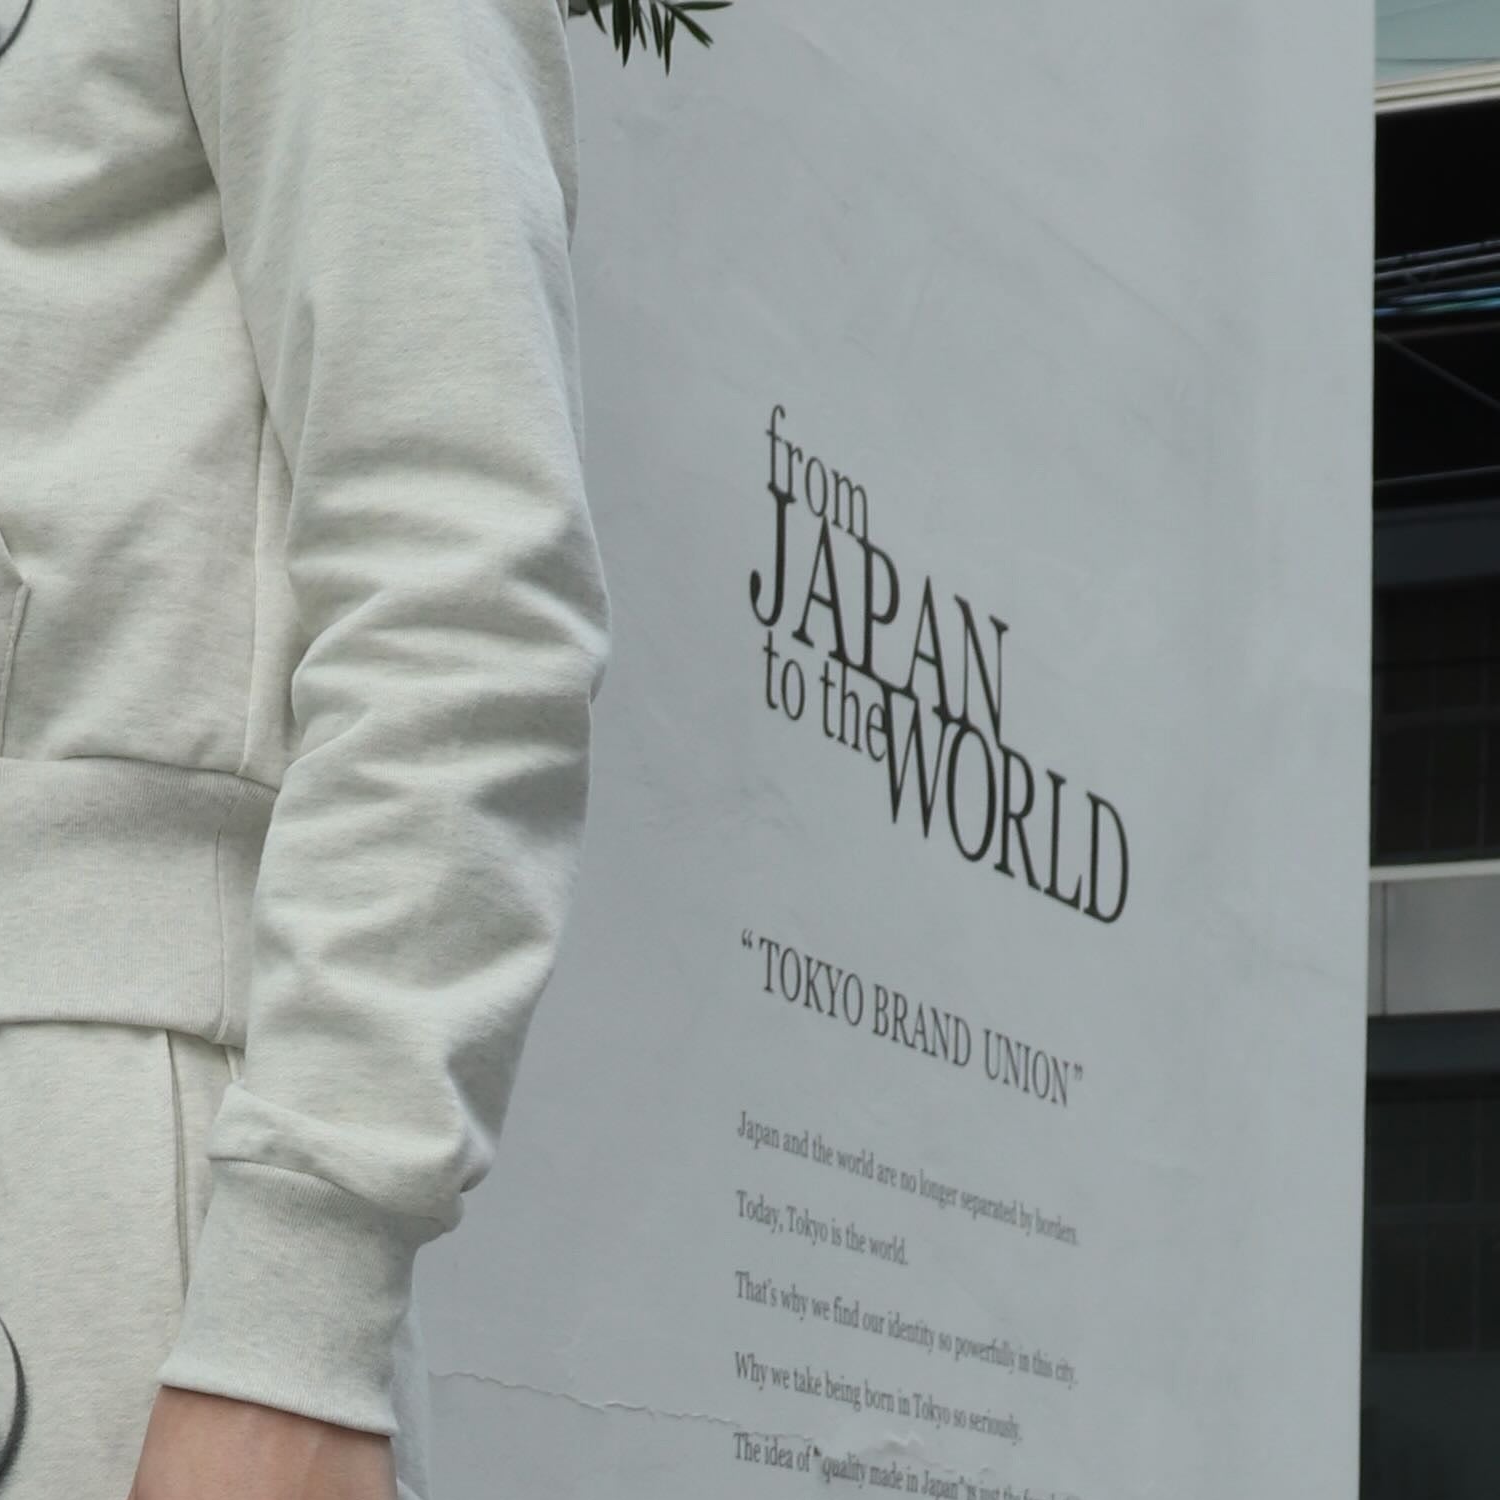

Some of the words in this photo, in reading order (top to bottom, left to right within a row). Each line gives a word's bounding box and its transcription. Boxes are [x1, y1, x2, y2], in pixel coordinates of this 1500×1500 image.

[765, 404, 869, 544] from
[750, 481, 1009, 748] JAPAN
[763, 630, 805, 721] to
[820, 655, 889, 762] the
[880, 682, 1129, 924] WORLD
[872, 984, 971, 1067] BRAND
[736, 1189, 784, 1234] Today,
[786, 1205, 828, 1246] Tokyo
[831, 1218, 842, 1247] is
[845, 1222, 866, 1253] the
[869, 1235, 908, 1265] world.
[737, 1111, 780, 1150] Japan
[783, 1130, 809, 1159] and
[812, 1134, 833, 1166] the
[836, 1149, 874, 1180] world
[877, 1163, 898, 1187] are
[900, 1171, 917, 1193] no
[919, 1168, 958, 1209] longer
[960, 1190, 1017, 1221] separated
[1019, 1201, 1034, 1236] by
[735, 1270, 777, 1307] That's
[780, 1283, 809, 1321] why
[812, 1298, 830, 1321] we
[833, 1296, 860, 1328] find
[862, 1311, 885, 1335] our
[888, 1310, 934, 1356] identity
[938, 1332, 952, 1352] so
[955, 1336, 1016, 1375] powerfully
[1018, 1345, 1030, 1373] in
[1032, 1350, 1053, 1378] this
[735, 1351, 768, 1391] Why
[771, 1367, 790, 1390] we
[793, 1366, 822, 1397] take
[825, 1370, 861, 1413] being
[864, 1378, 894, 1413] born
[898, 1388, 910, 1416] in
[912, 1392, 951, 1430] Tokyo
[953, 1409, 967, 1429] so
[969, 1408, 1023, 1447] seriously.
[733, 1432, 762, 1463] The
[764, 1436, 794, 1470] idea
[796, 1445, 812, 1473] of
[869, 1460, 903, 1490] made
[906, 1466, 919, 1493] in
